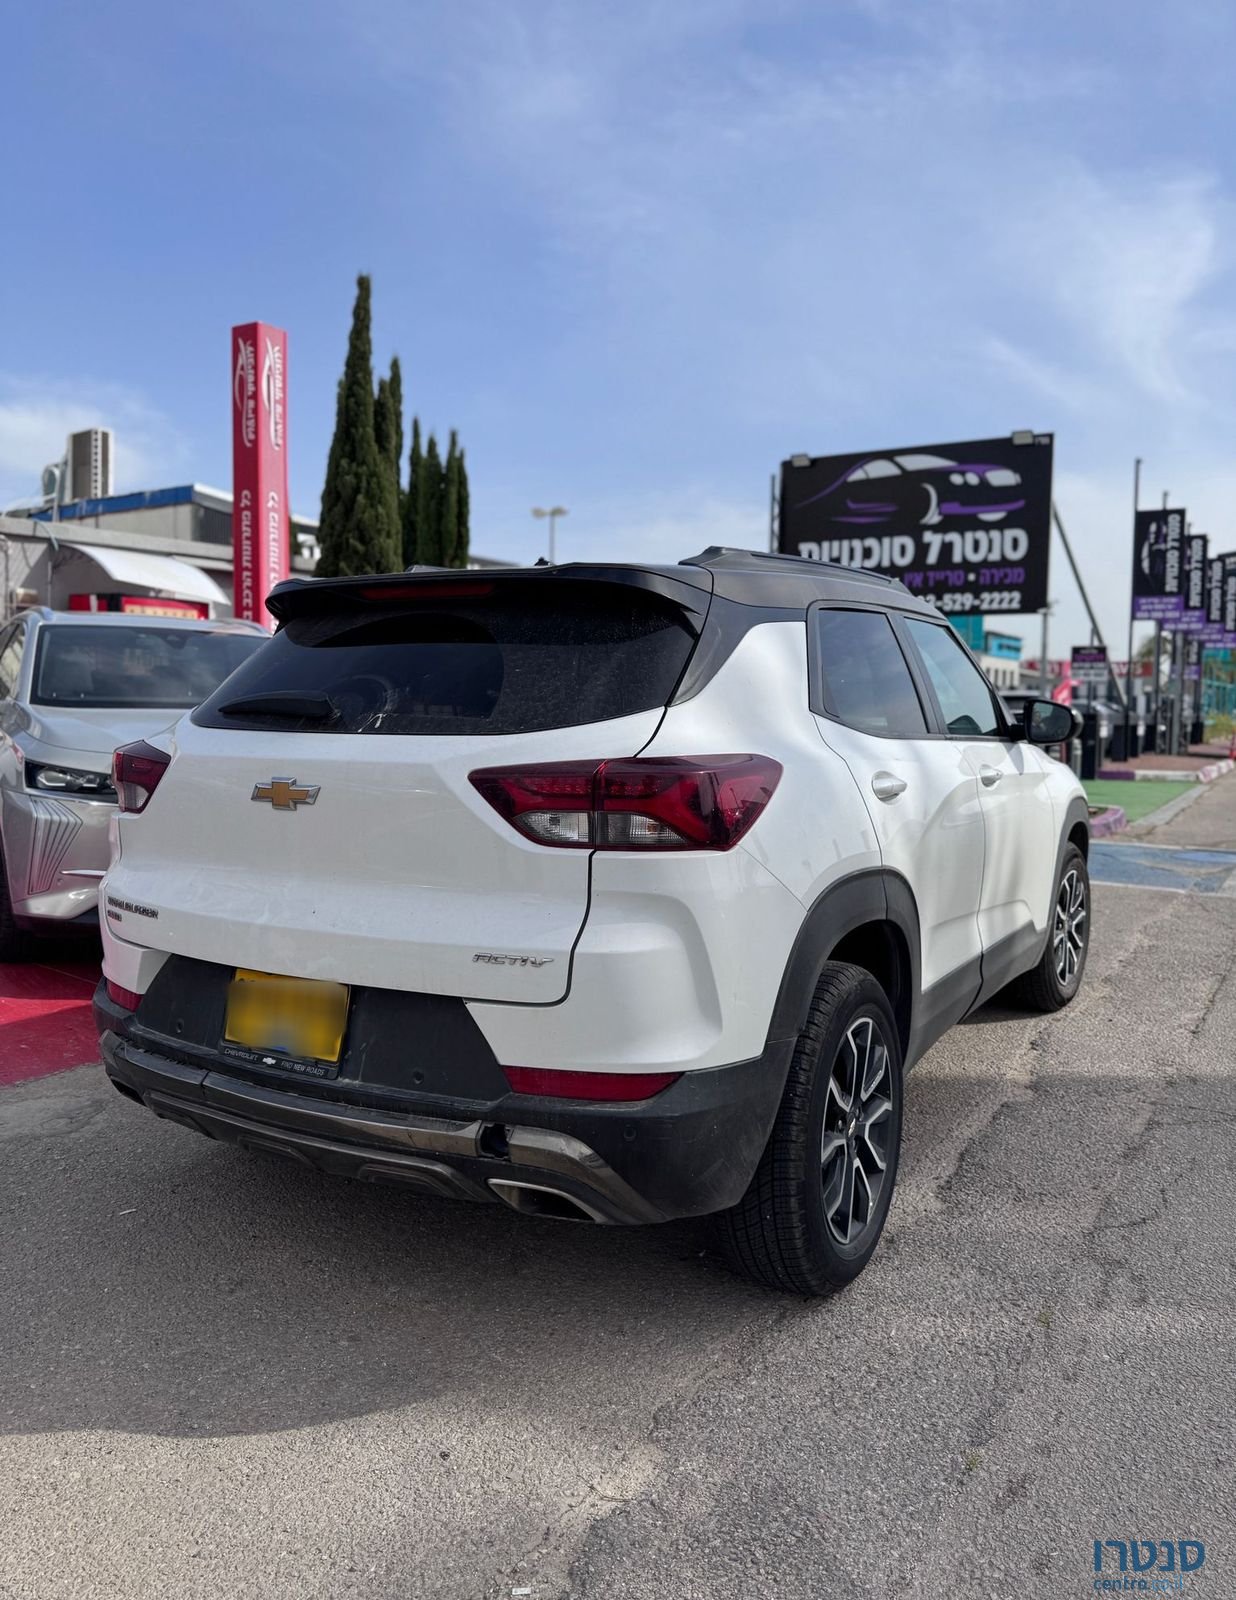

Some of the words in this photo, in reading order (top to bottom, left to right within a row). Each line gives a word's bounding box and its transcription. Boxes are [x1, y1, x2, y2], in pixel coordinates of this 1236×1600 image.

[922, 528, 1029, 565] סנטרל
[979, 567, 1025, 585] מכירה
[917, 591, 1021, 611] 2-529-2222
[472, 952, 555, 968] ACTIV
[224, 1048, 259, 1061] CHEVROLET
[292, 1063, 305, 1073] NEW
[305, 1066, 325, 1076] ROADS
